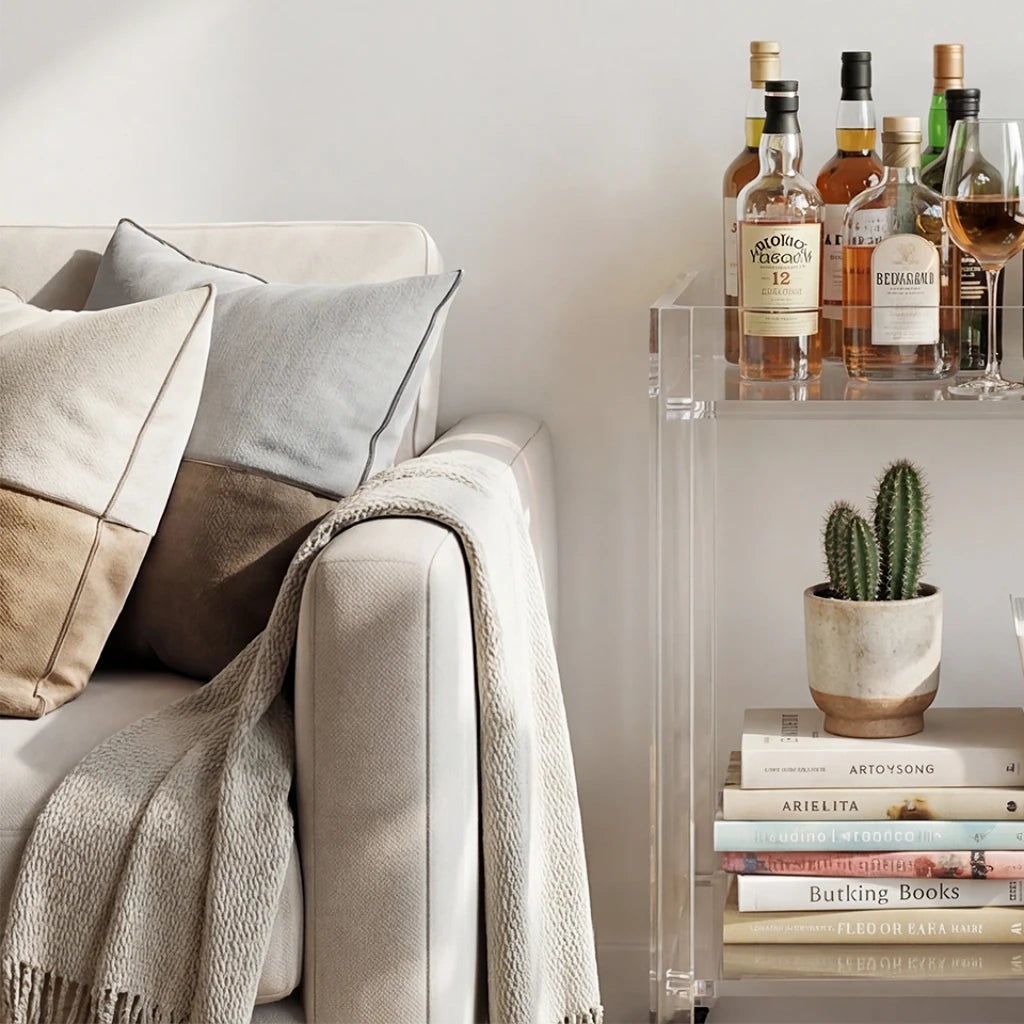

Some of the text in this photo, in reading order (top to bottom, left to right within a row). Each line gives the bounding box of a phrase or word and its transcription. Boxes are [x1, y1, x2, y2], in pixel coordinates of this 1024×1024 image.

[772, 271, 790, 286] 12
[850, 764, 935, 775] ARTOYSONG
[782, 800, 859, 812] ARIELITA
[809, 883, 960, 905] Butking Books
